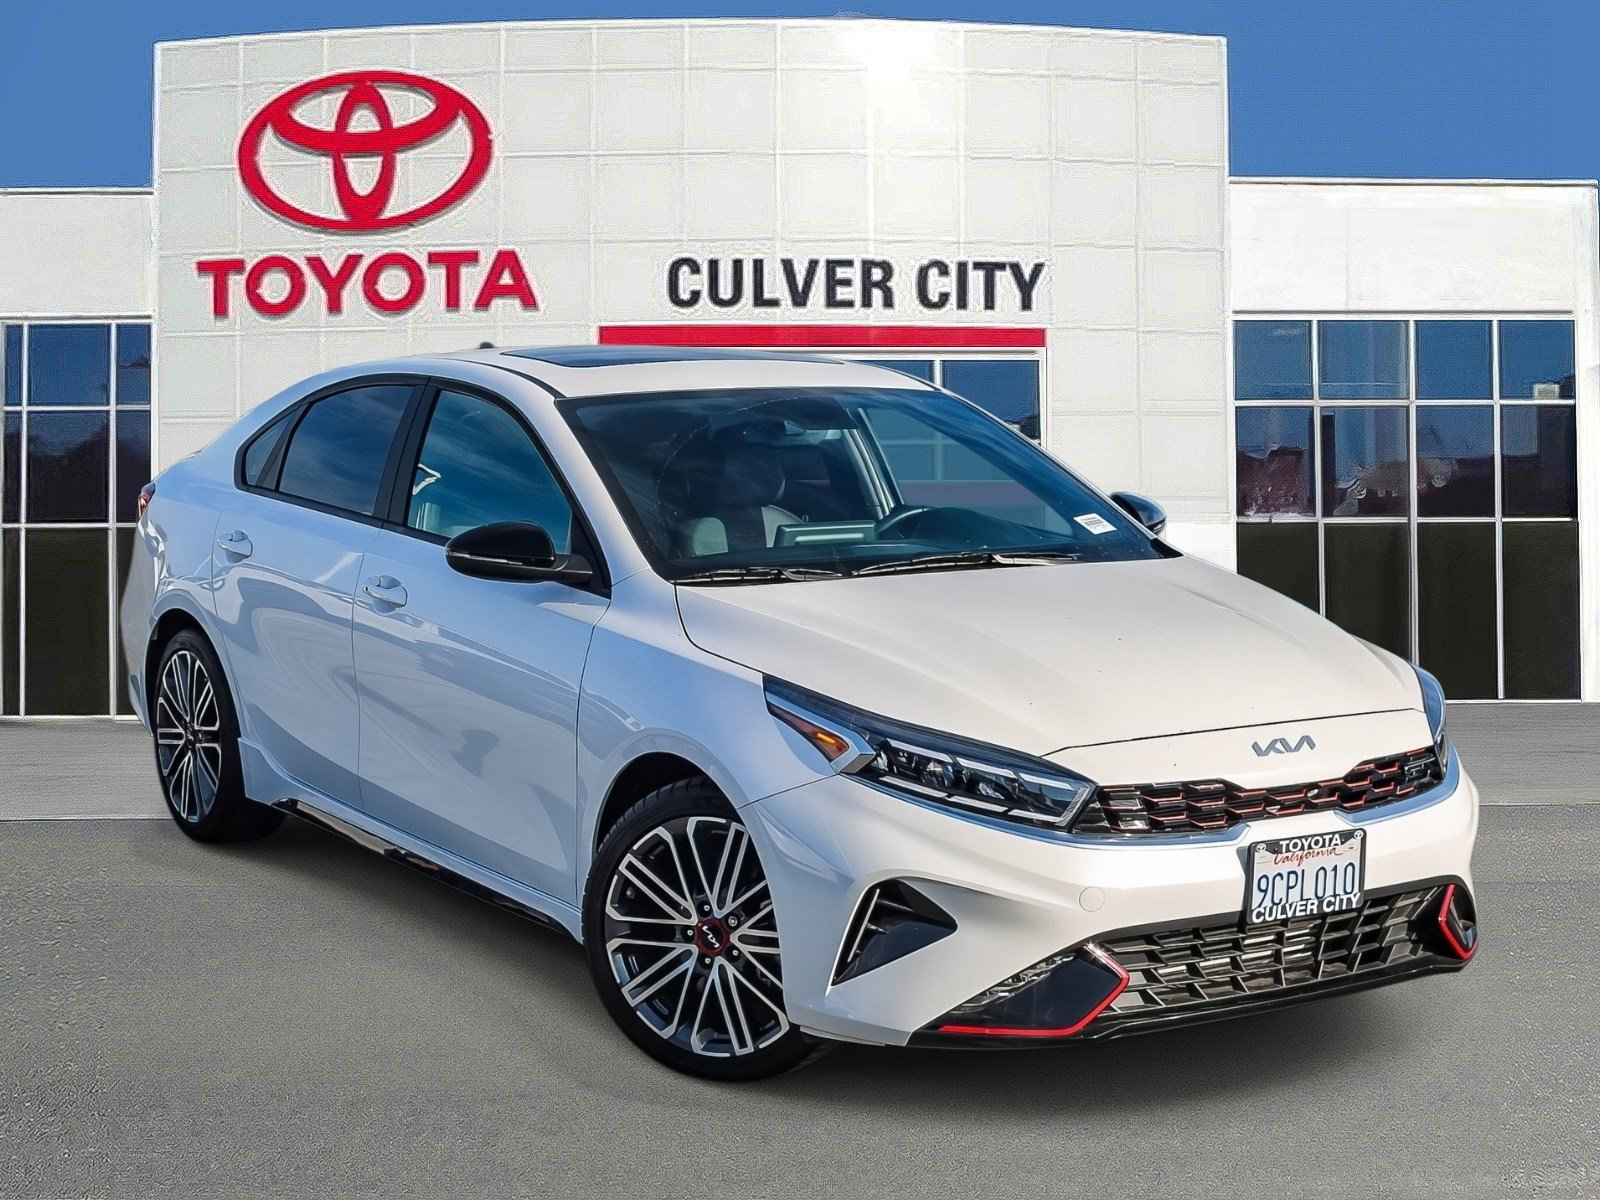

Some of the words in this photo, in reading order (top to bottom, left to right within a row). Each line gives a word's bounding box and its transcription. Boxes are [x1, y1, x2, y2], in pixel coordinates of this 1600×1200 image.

[195, 250, 540, 319] TOYOTA
[667, 257, 895, 309] CULVER
[915, 259, 1046, 312] CITY
[1273, 847, 1345, 867] California
[1279, 833, 1342, 853] TOYOTA
[1257, 861, 1356, 907] 9CPL010
[1252, 899, 1318, 924] CULVER
[1322, 892, 1361, 913] CITY
